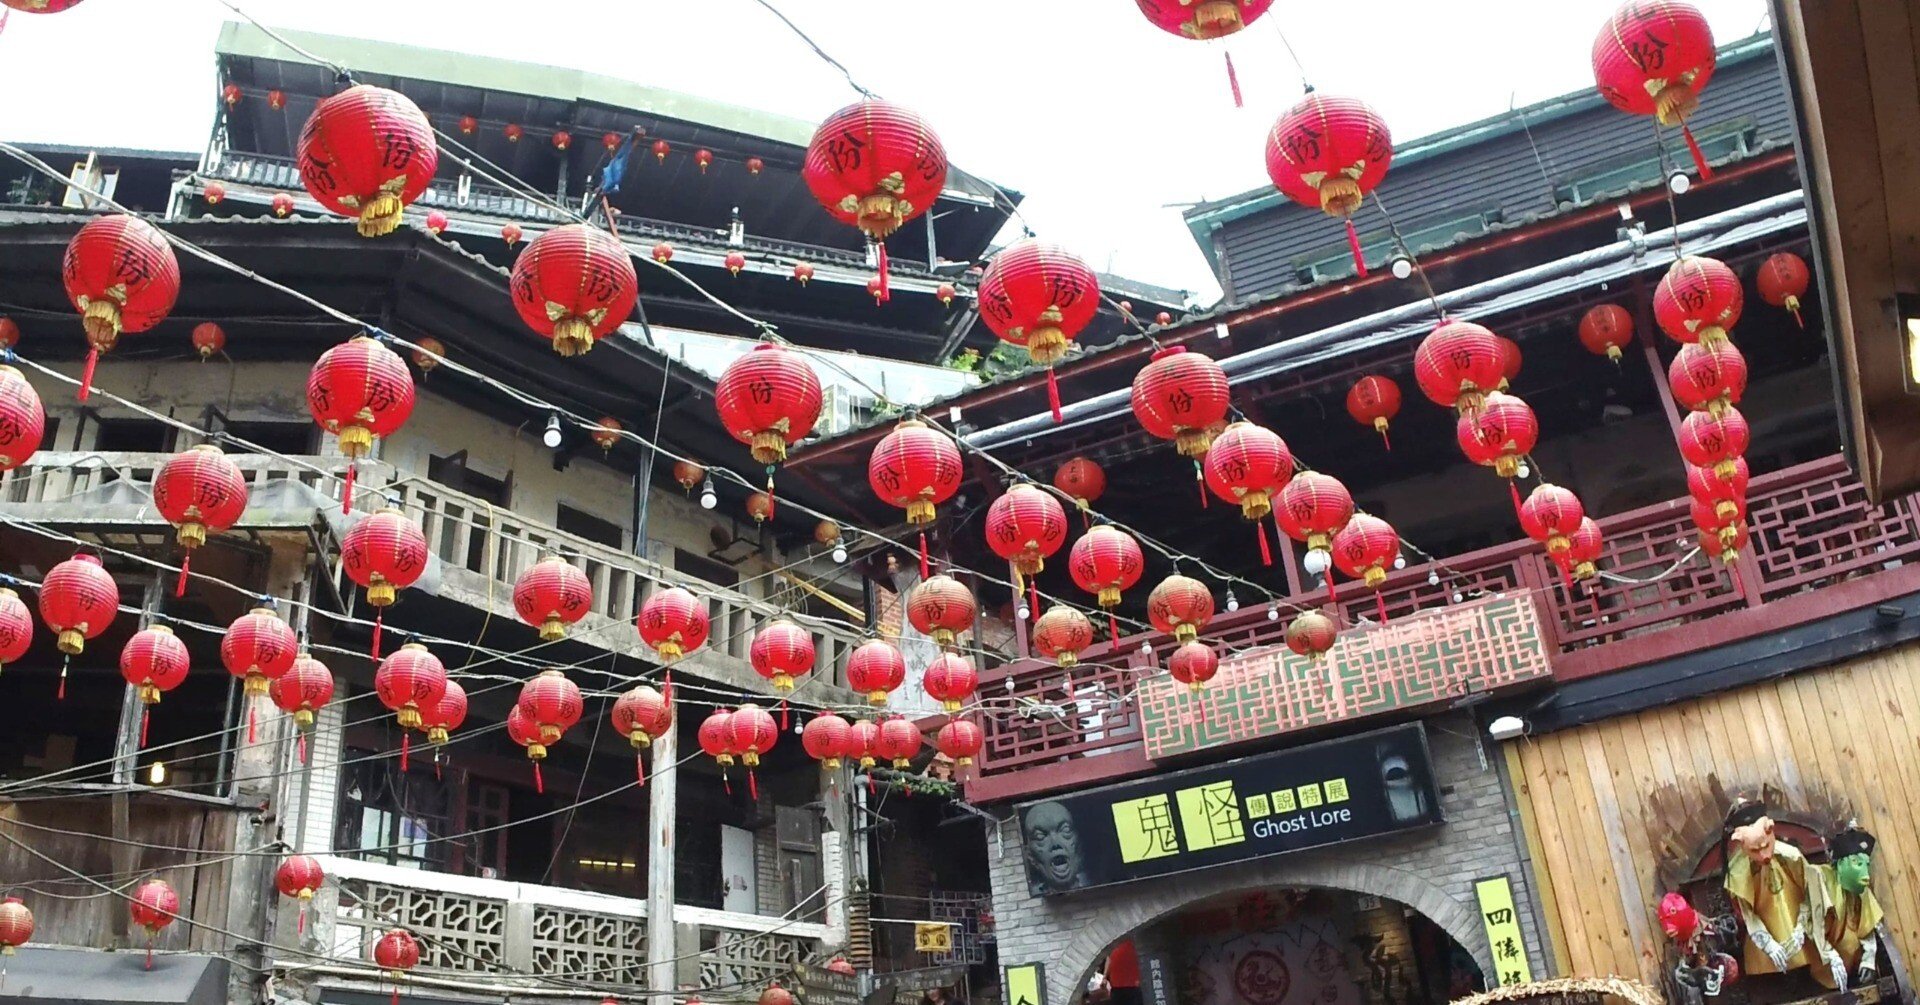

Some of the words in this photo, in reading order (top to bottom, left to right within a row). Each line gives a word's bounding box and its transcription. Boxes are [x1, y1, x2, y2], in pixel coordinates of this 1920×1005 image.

[1249, 780, 1347, 816] 傳說特展
[1253, 813, 1308, 839] Ghost
[1310, 807, 1352, 829] Lore
